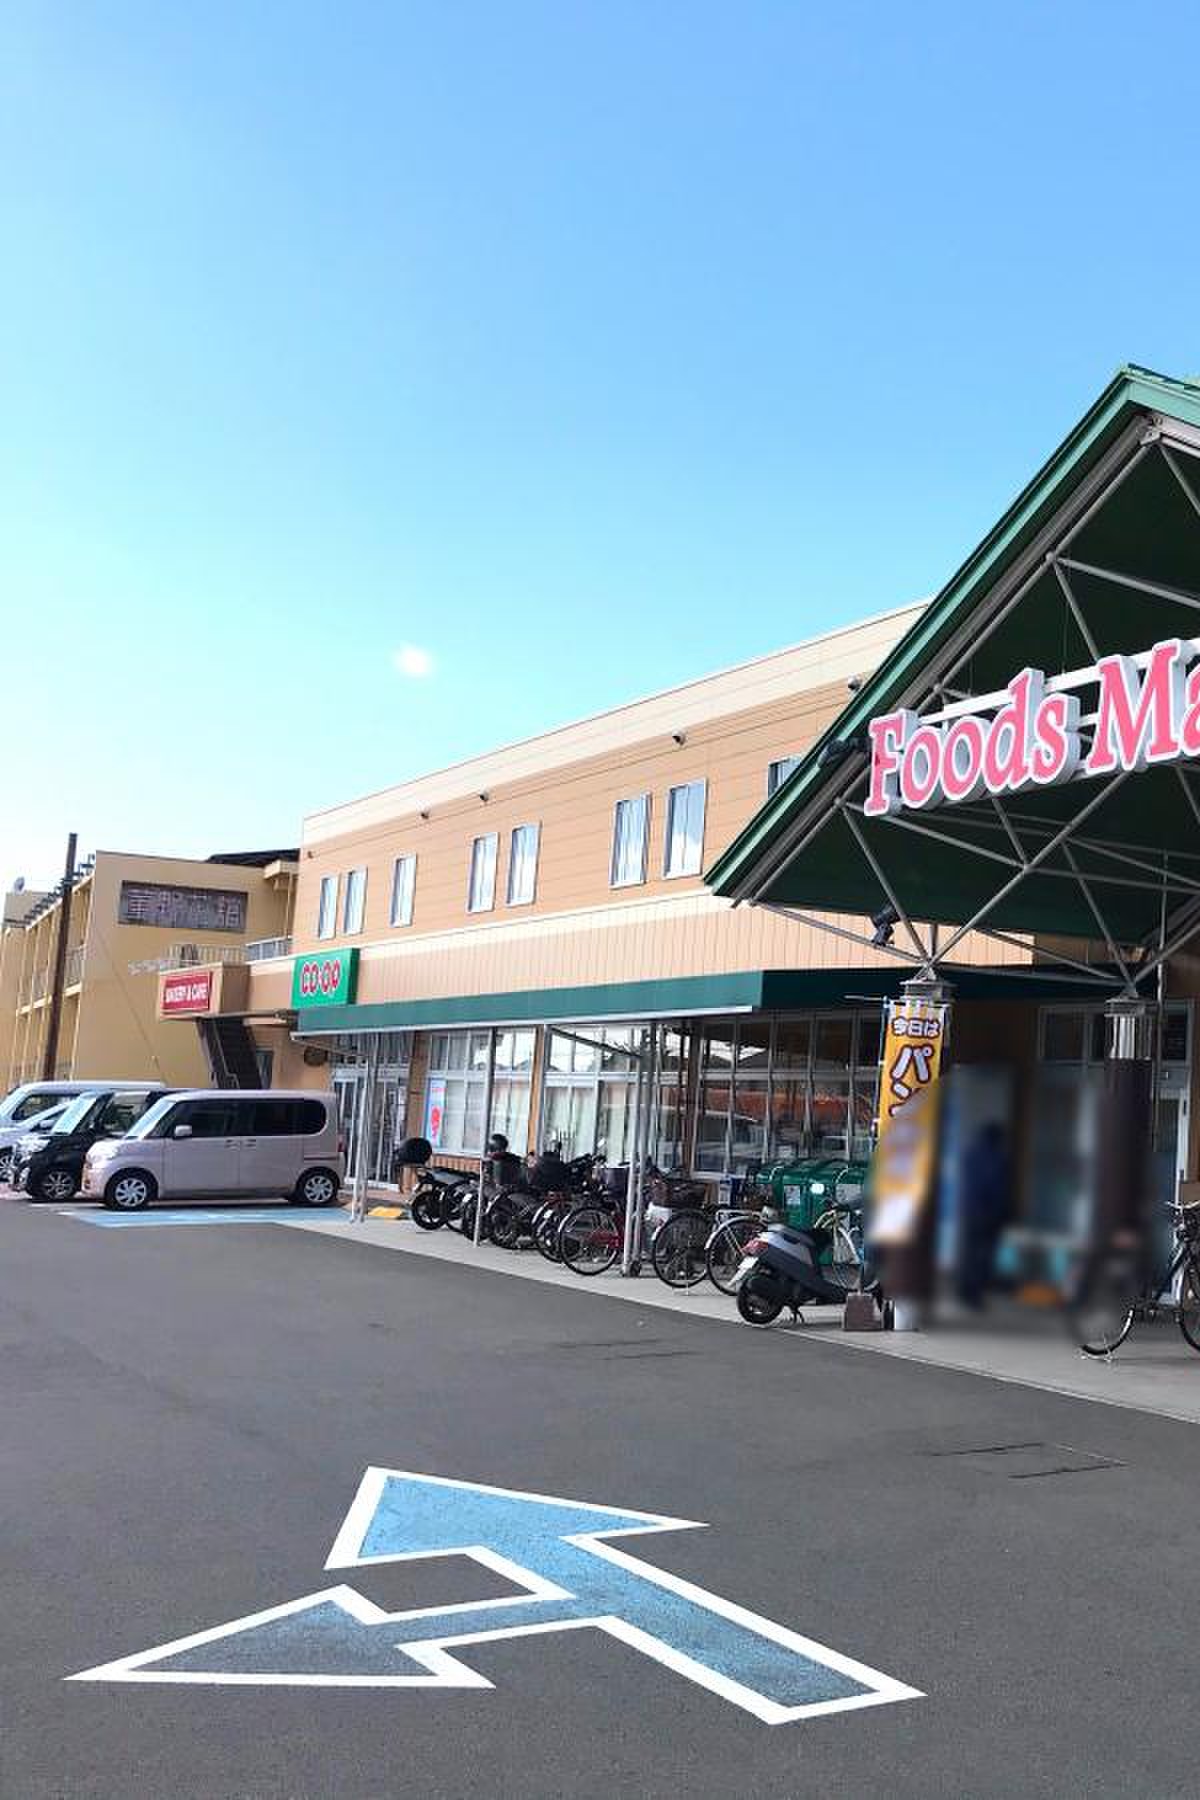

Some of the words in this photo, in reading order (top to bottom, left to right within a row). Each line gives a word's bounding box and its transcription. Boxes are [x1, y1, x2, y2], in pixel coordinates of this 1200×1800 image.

[864, 667, 1073, 816] Foods
[892, 1017, 940, 1038] 今日は
